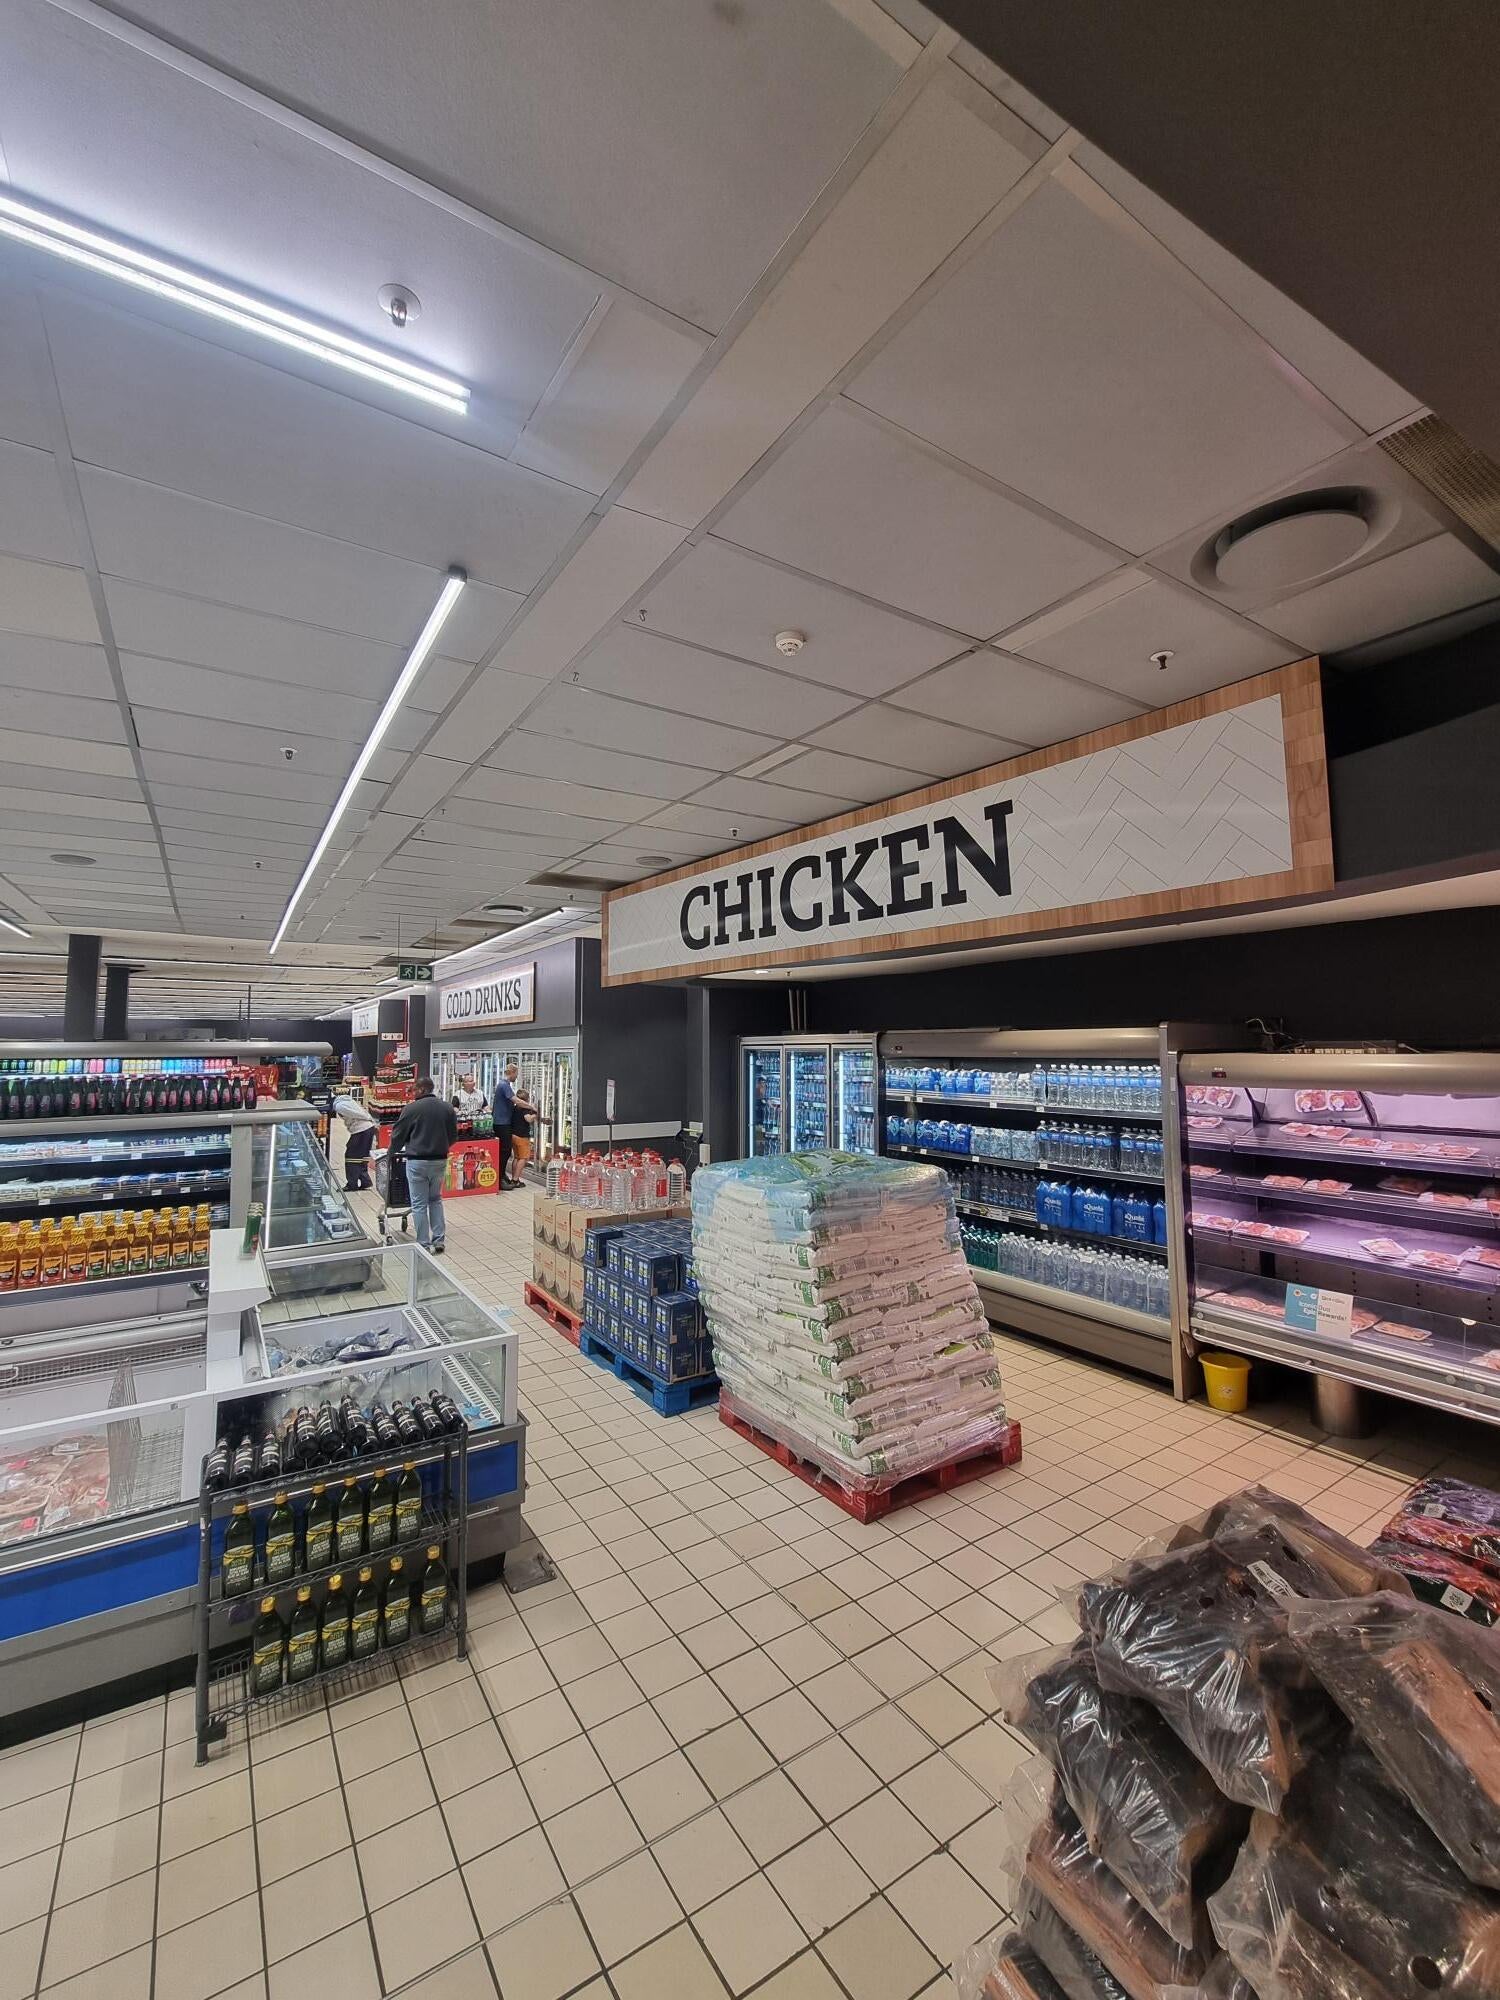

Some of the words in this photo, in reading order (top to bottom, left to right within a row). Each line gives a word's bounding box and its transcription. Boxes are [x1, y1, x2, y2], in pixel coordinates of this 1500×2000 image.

[680, 800, 1013, 950] CHICKEN
[446, 991, 471, 1018] COLD
[475, 978, 521, 1015] DRINKS
